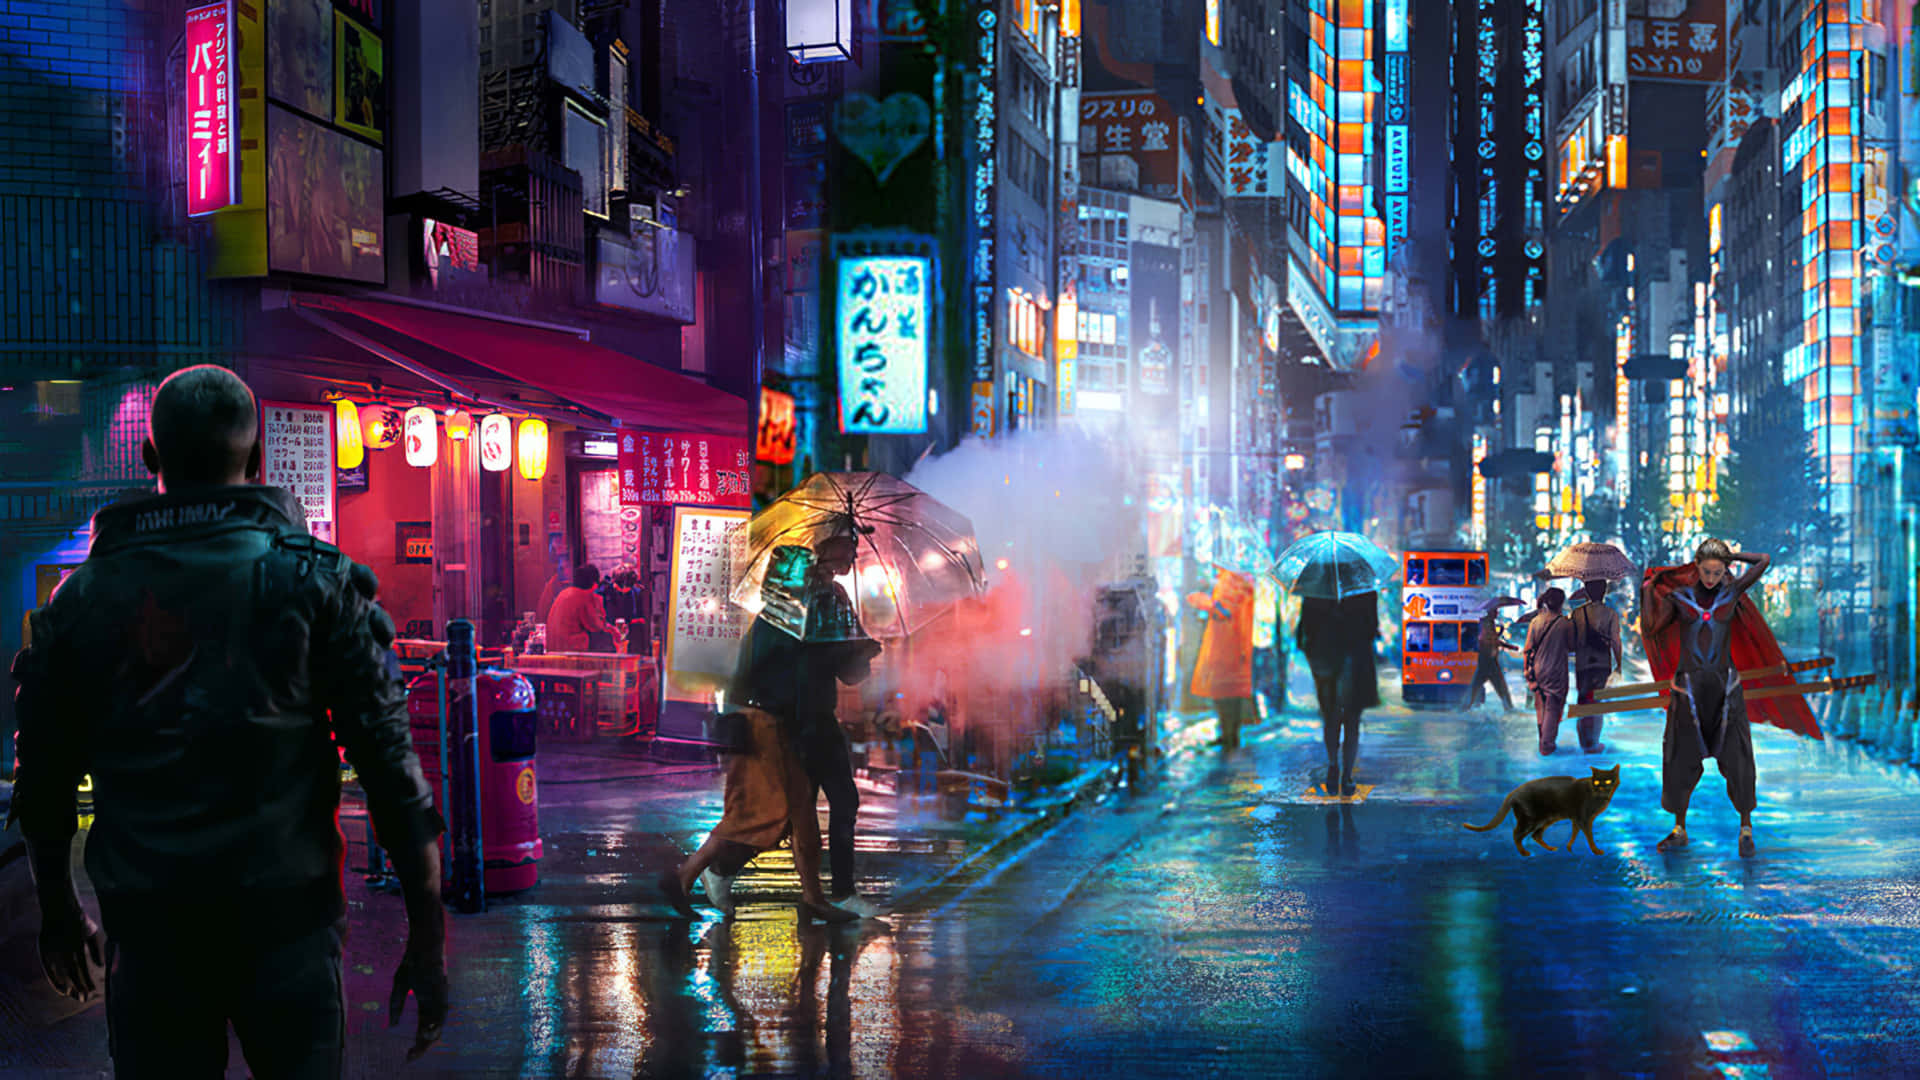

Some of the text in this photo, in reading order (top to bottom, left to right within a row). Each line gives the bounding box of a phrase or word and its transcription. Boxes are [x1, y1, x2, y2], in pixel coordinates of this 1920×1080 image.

[190, 40, 213, 200] バーミィー
[1083, 99, 1155, 119] クスリの
[851, 265, 890, 426] かんちゃん
